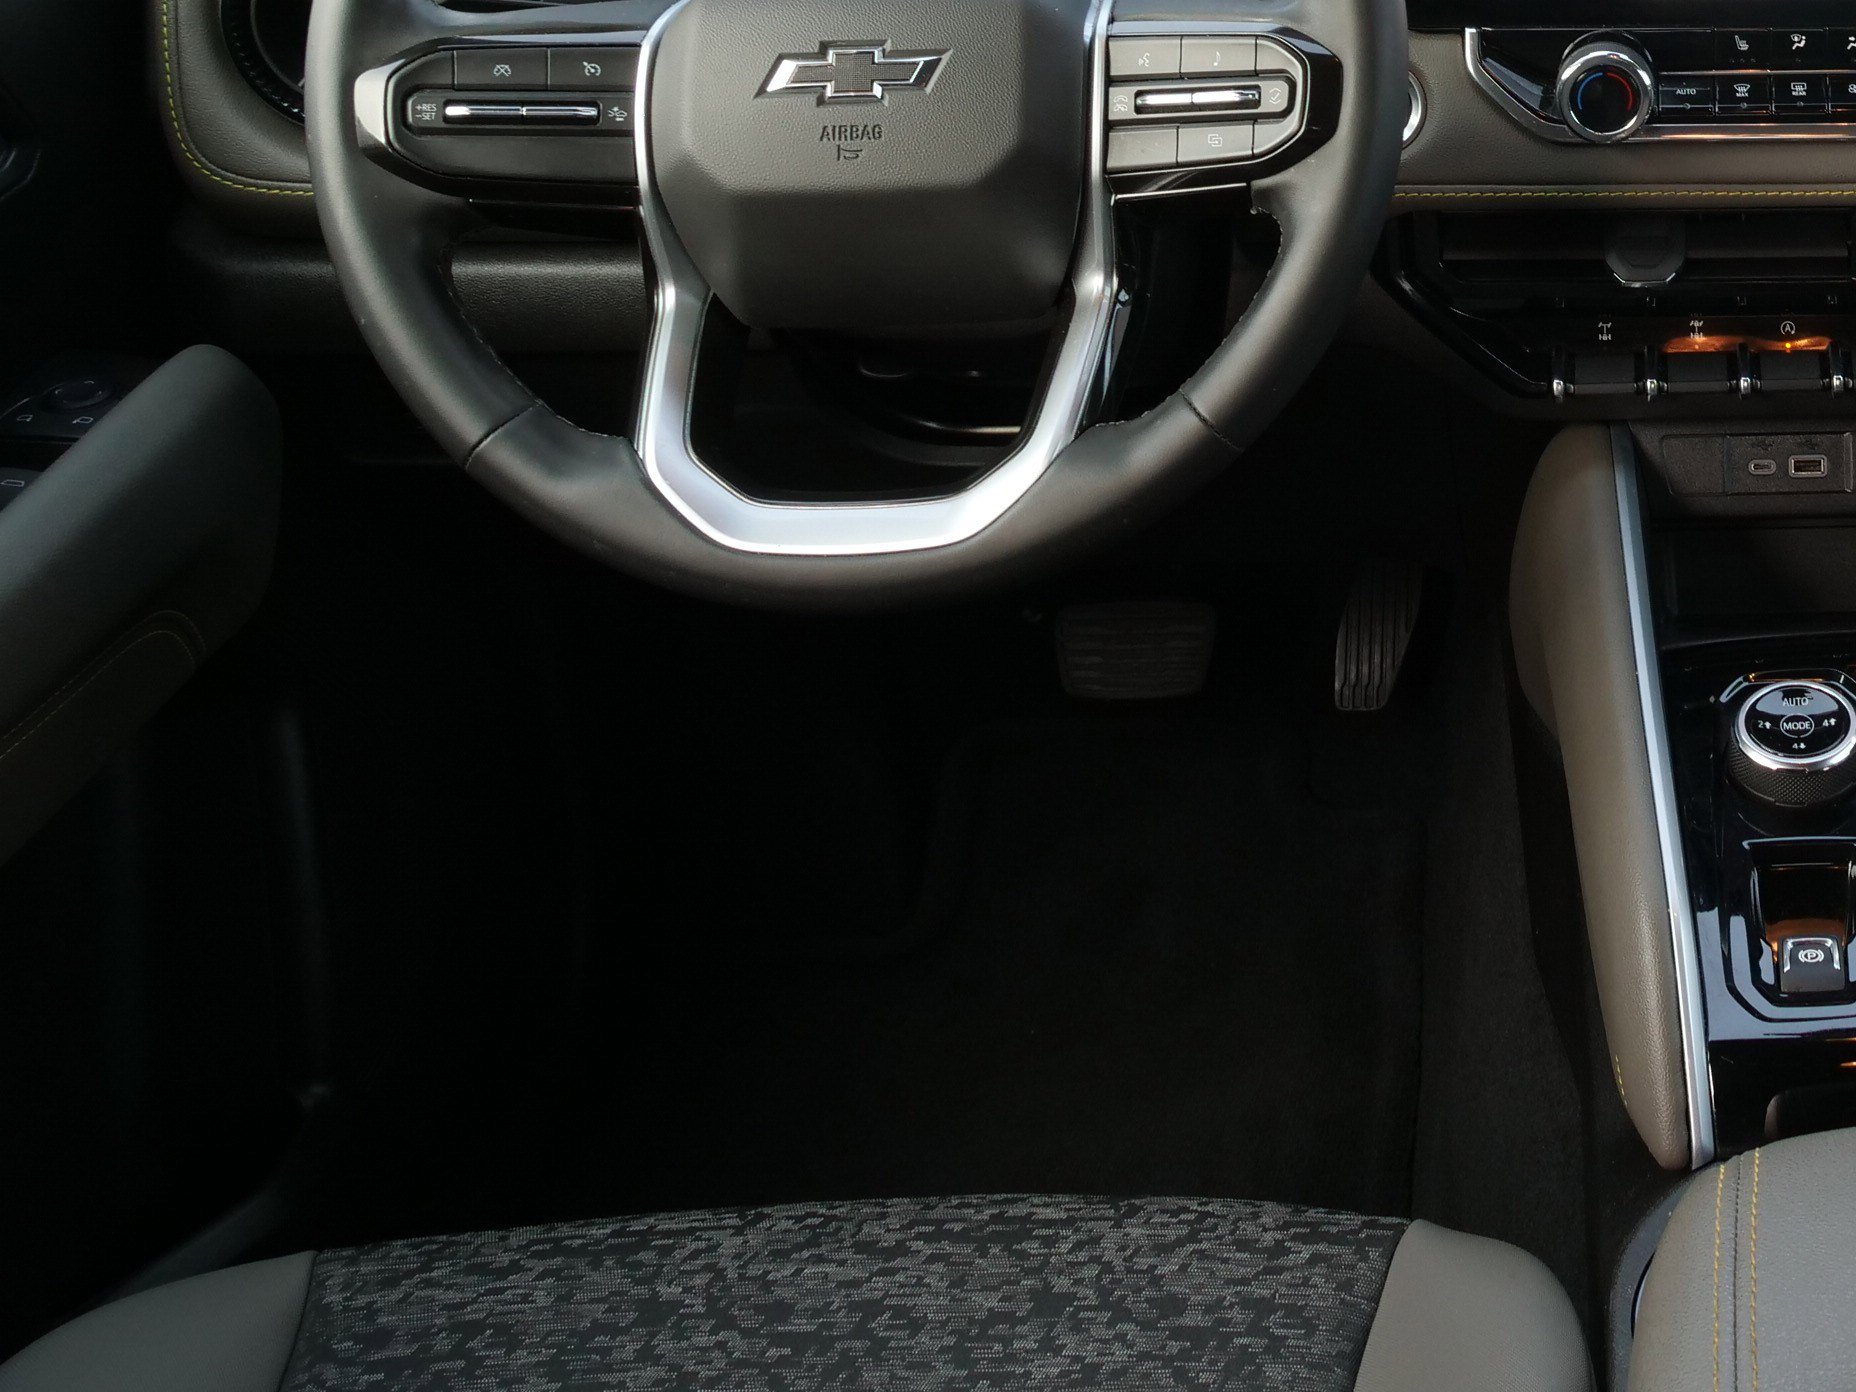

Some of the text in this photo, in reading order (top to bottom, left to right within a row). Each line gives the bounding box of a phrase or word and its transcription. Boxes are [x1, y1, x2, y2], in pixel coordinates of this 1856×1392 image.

[1675, 88, 1697, 96] AUTO
[820, 123, 883, 142] AIRBAG
[1782, 696, 1809, 707] AUTO
[1783, 721, 1811, 731] MODE
